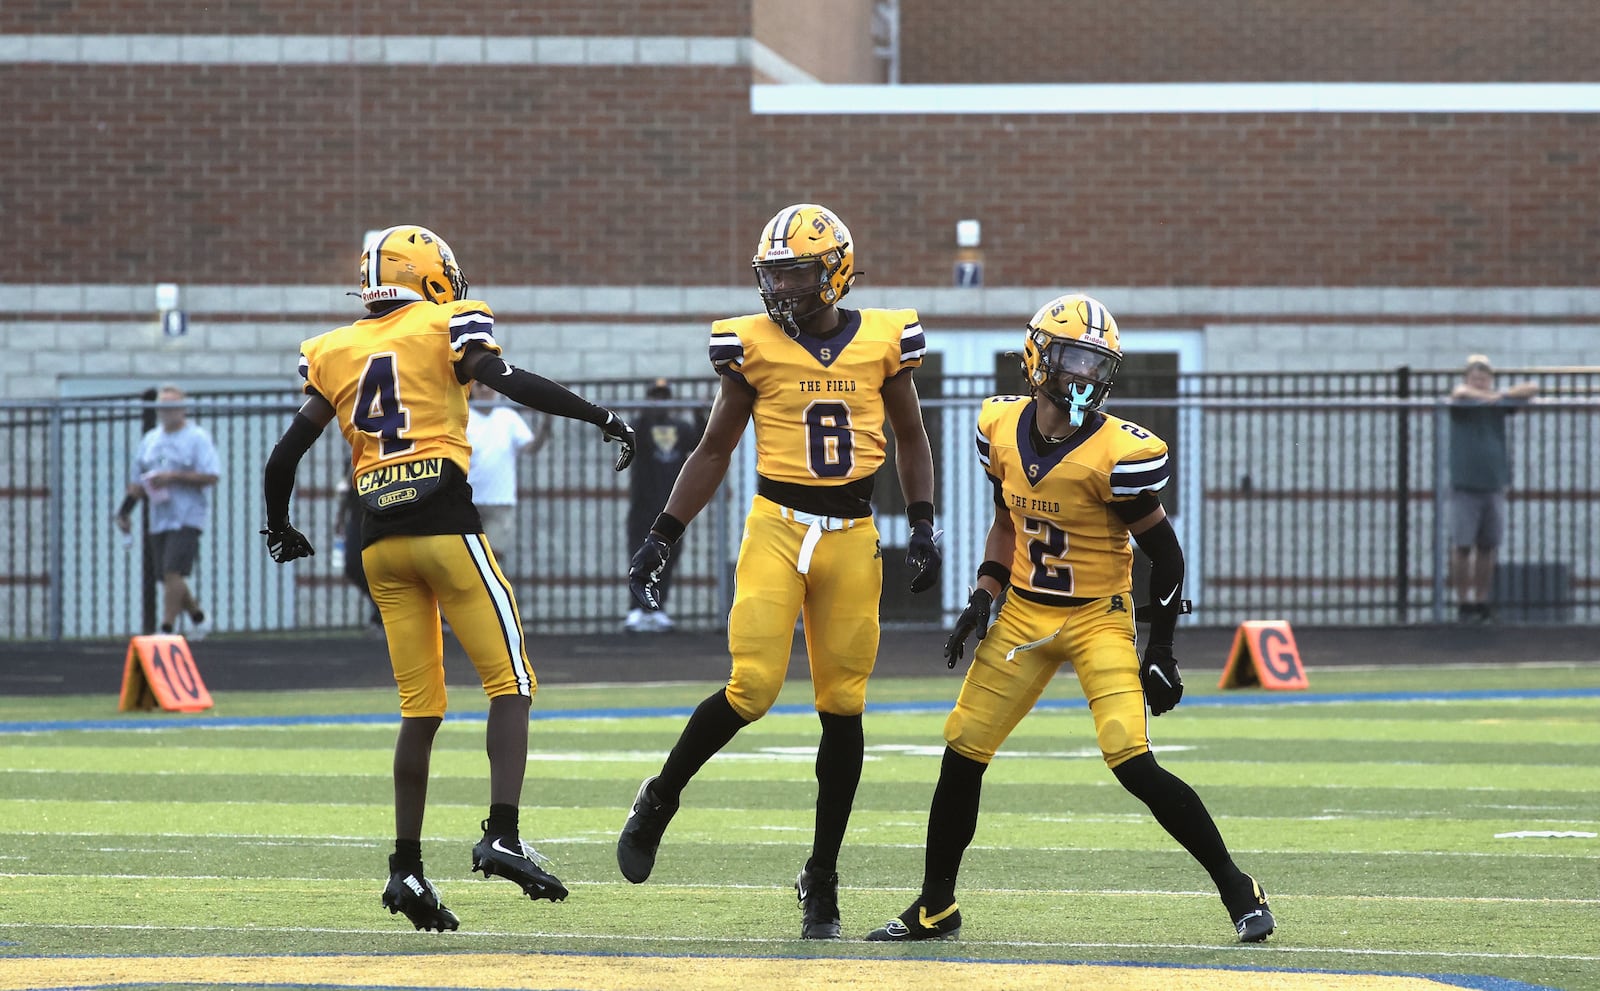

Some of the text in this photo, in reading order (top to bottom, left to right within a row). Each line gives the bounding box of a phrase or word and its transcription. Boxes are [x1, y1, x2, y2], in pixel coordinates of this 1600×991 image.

[767, 249, 789, 257] Riddell
[362, 288, 398, 302] Riddell
[820, 348, 832, 361] S
[799, 380, 857, 392] THE FIELD
[351, 351, 415, 460] 4
[1121, 423, 1151, 440] 2
[359, 458, 440, 491] CAUTION
[1028, 464, 1040, 478] S
[1011, 494, 1061, 513] THE FIELD
[1023, 515, 1075, 597] 2
[1259, 628, 1301, 682] G
[152, 644, 199, 701] 10
[402, 873, 425, 897] NIKE
